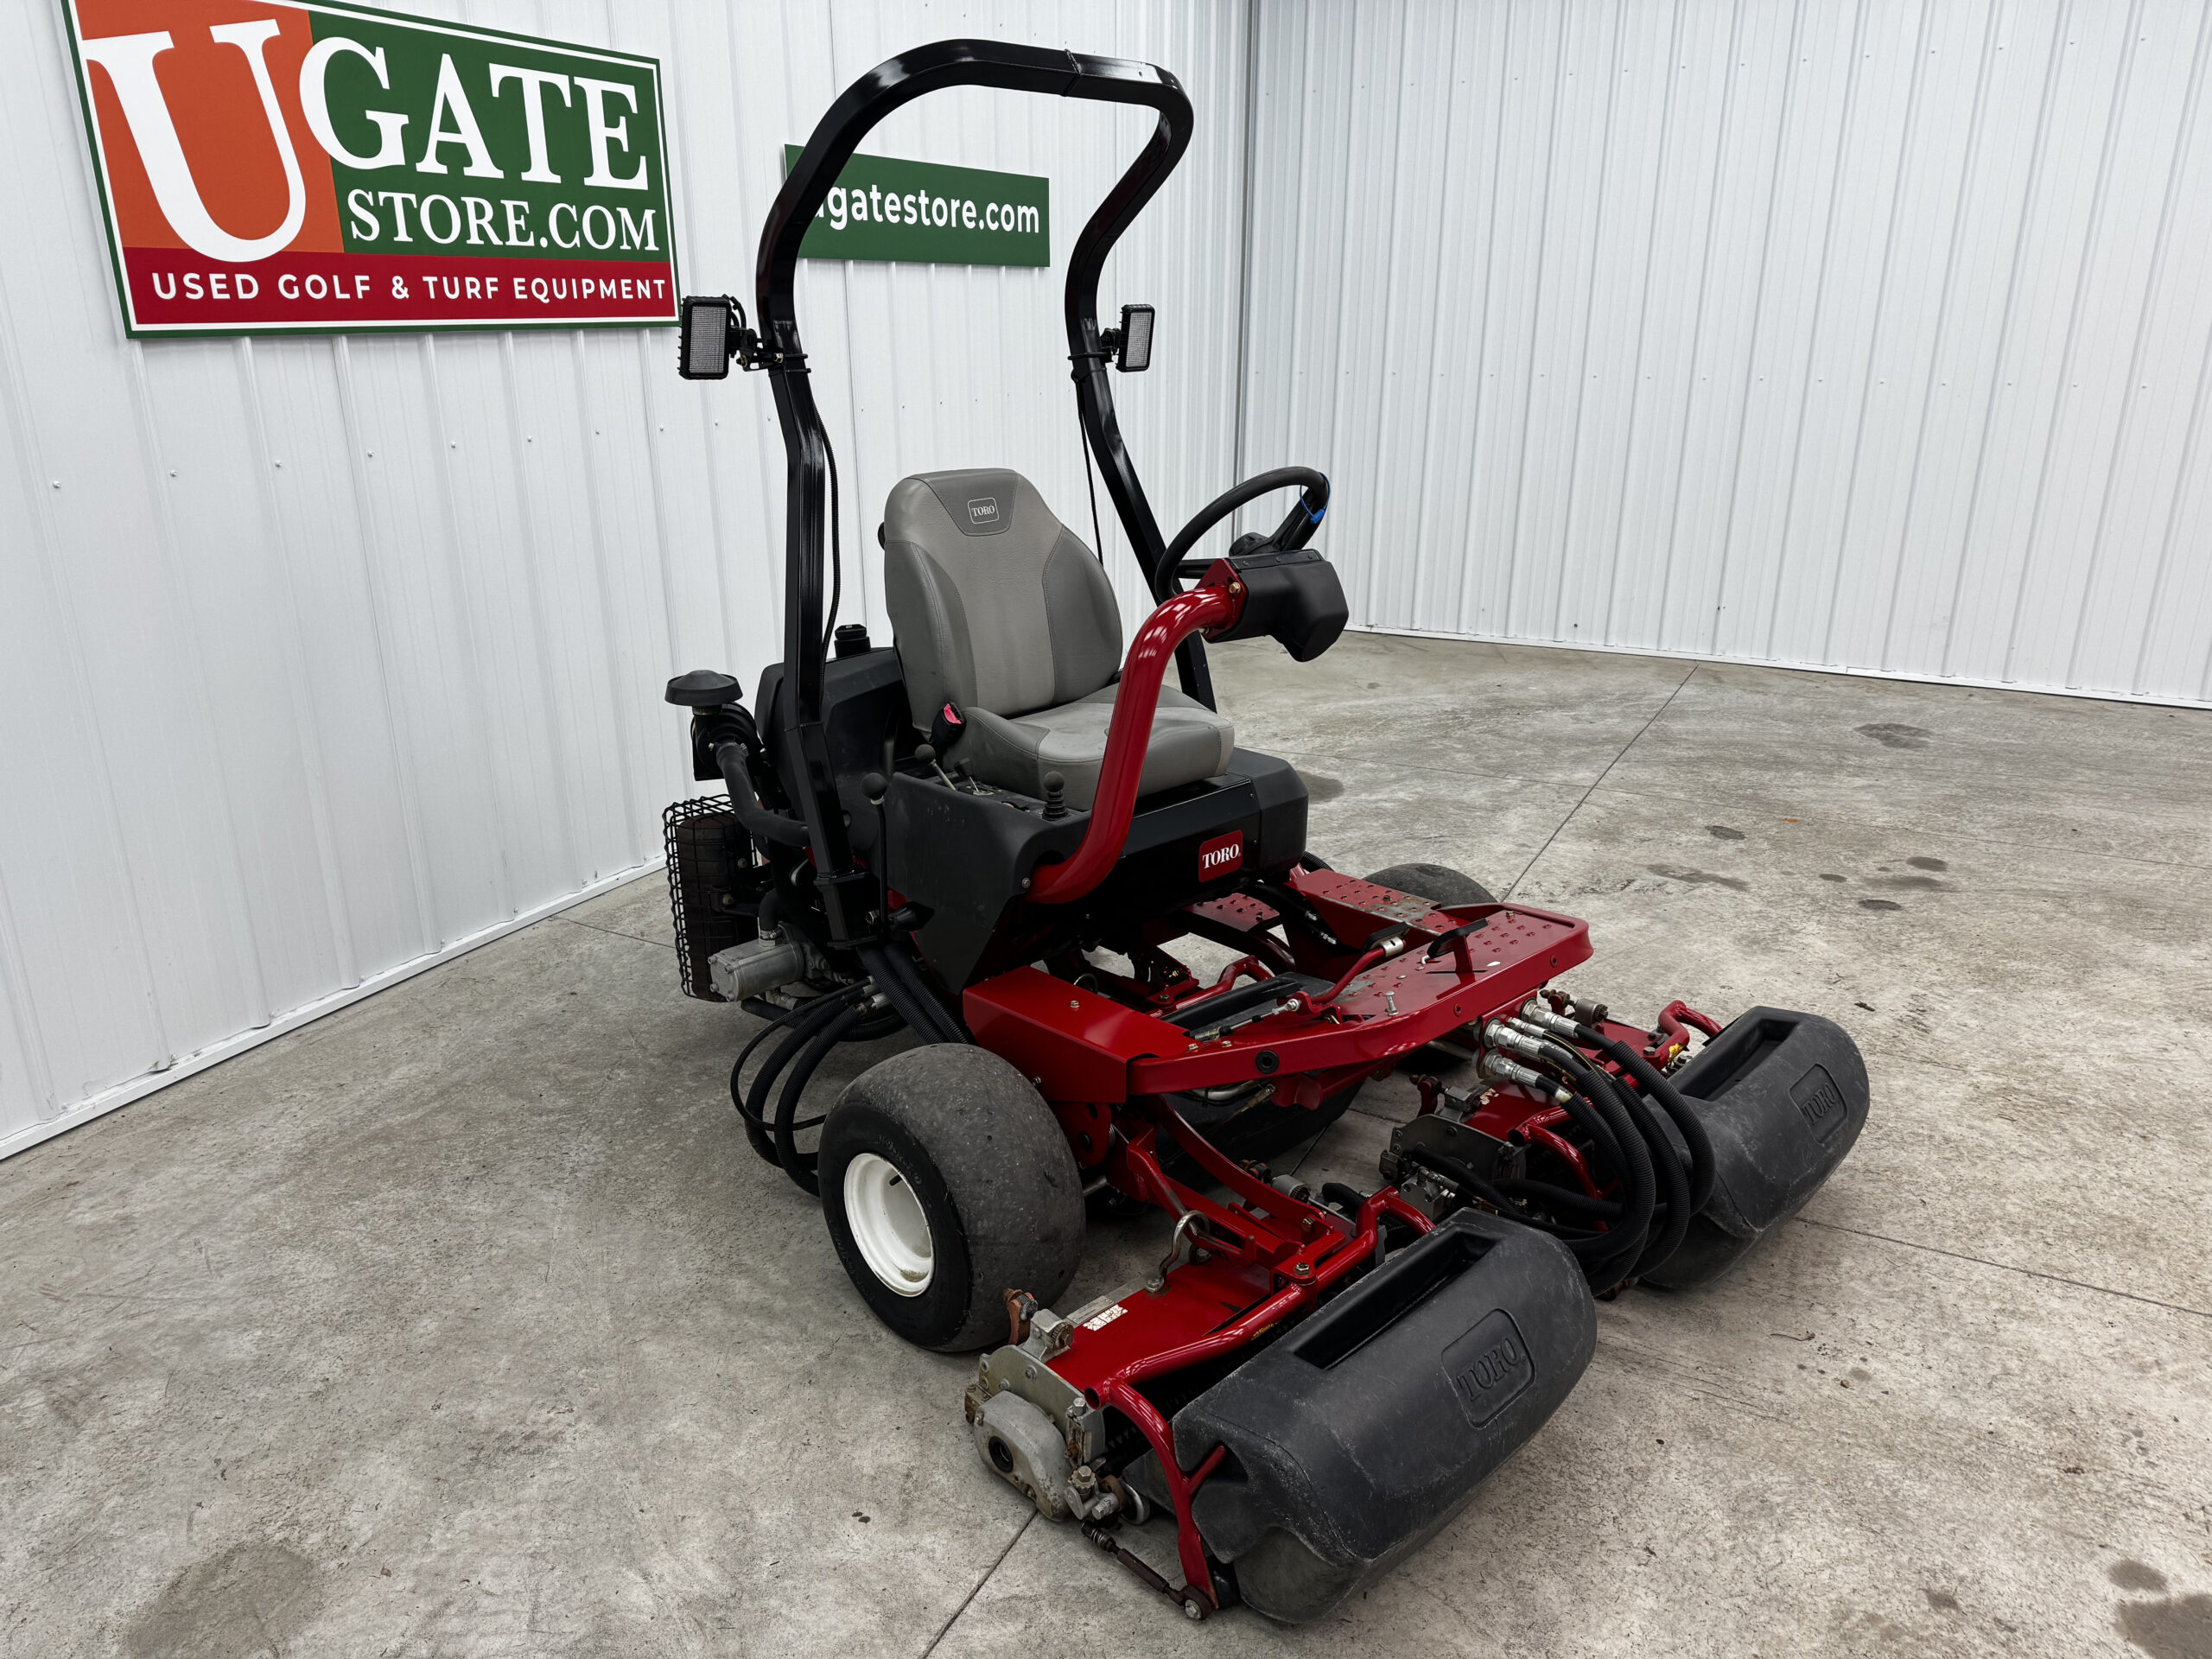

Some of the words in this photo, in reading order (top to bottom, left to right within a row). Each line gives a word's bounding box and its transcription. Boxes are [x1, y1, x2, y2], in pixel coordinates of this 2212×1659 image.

[349, 188, 659, 251] STORE.COM
[814, 184, 1039, 233] gatestore.com
[151, 272, 260, 301] USED
[277, 274, 372, 300] GOLF
[391, 275, 410, 300] &
[423, 276, 499, 300] TURF
[514, 277, 666, 303] EQUIPMENT
[971, 505, 995, 517] TORO
[1202, 843, 1239, 869] TORO
[1456, 1337, 1518, 1402] TORO
